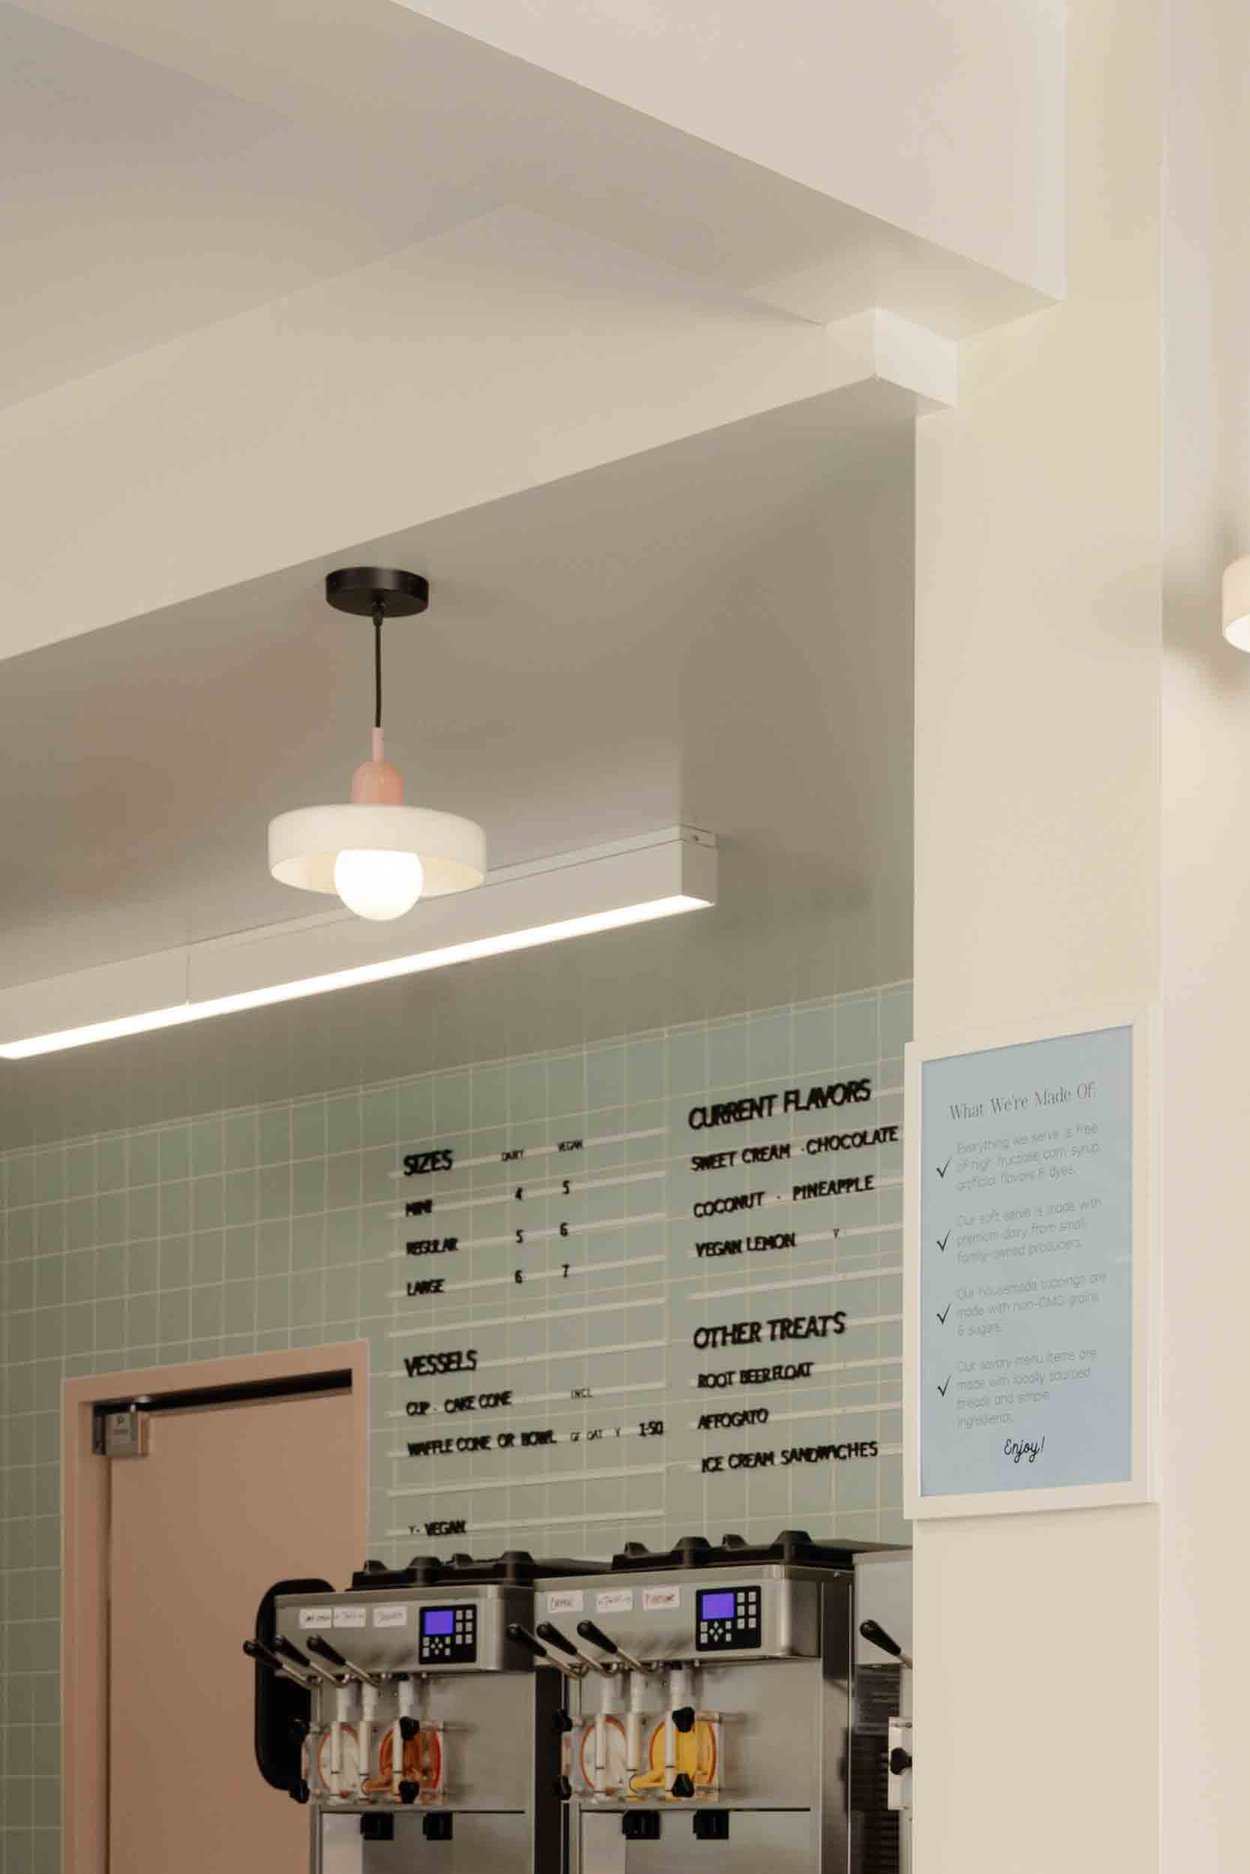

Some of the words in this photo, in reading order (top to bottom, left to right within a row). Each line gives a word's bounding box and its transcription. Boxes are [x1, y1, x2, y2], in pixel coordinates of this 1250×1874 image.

[687, 1093, 779, 1131] CURRENT
[783, 1077, 872, 1113] FLAVORS
[949, 1102, 984, 1121] What
[991, 1095, 1028, 1115] We're
[1035, 1086, 1071, 1107] Made
[403, 1148, 454, 1177] SIZES
[557, 1139, 583, 1152] VEGAN
[690, 1150, 738, 1172] SWEET
[741, 1143, 791, 1164] CREAM
[805, 1125, 899, 1156] CHOCOLATE
[515, 1187, 523, 1201] 4
[562, 1179, 571, 1195] 5
[692, 1190, 766, 1219] COCONUT
[792, 1174, 875, 1202] PINEAPPLE
[405, 1237, 459, 1256] REGULAR
[515, 1229, 524, 1244] 5
[559, 1221, 569, 1238] 6
[695, 1239, 743, 1258] VEGAN
[746, 1232, 797, 1252] LEMON
[406, 1278, 445, 1297] LARGE
[514, 1269, 523, 1284] 6
[561, 1263, 571, 1279] 7
[693, 1321, 763, 1350] OTHER
[766, 1310, 847, 1342] TREATS
[403, 1349, 478, 1379] VESSELS
[697, 1370, 737, 1390] ROOT
[739, 1367, 773, 1386] BEER
[772, 1361, 815, 1382] FLOAT
[405, 1400, 431, 1417] CUP
[443, 1395, 476, 1414] CAKE
[477, 1390, 513, 1410] CONE
[697, 1407, 770, 1430] AFFOGATO
[407, 1438, 454, 1458] WAFFLE
[455, 1435, 492, 1453] CONE
[496, 1432, 516, 1449] OR
[520, 1429, 558, 1447] BOWL
[701, 1455, 724, 1474] ICE
[727, 1450, 775, 1470] CREAM
[780, 1440, 879, 1466] SANDWICHES
[1003, 1435, 1046, 1464] Enjoy!
[424, 1519, 467, 1537] VEGAN
